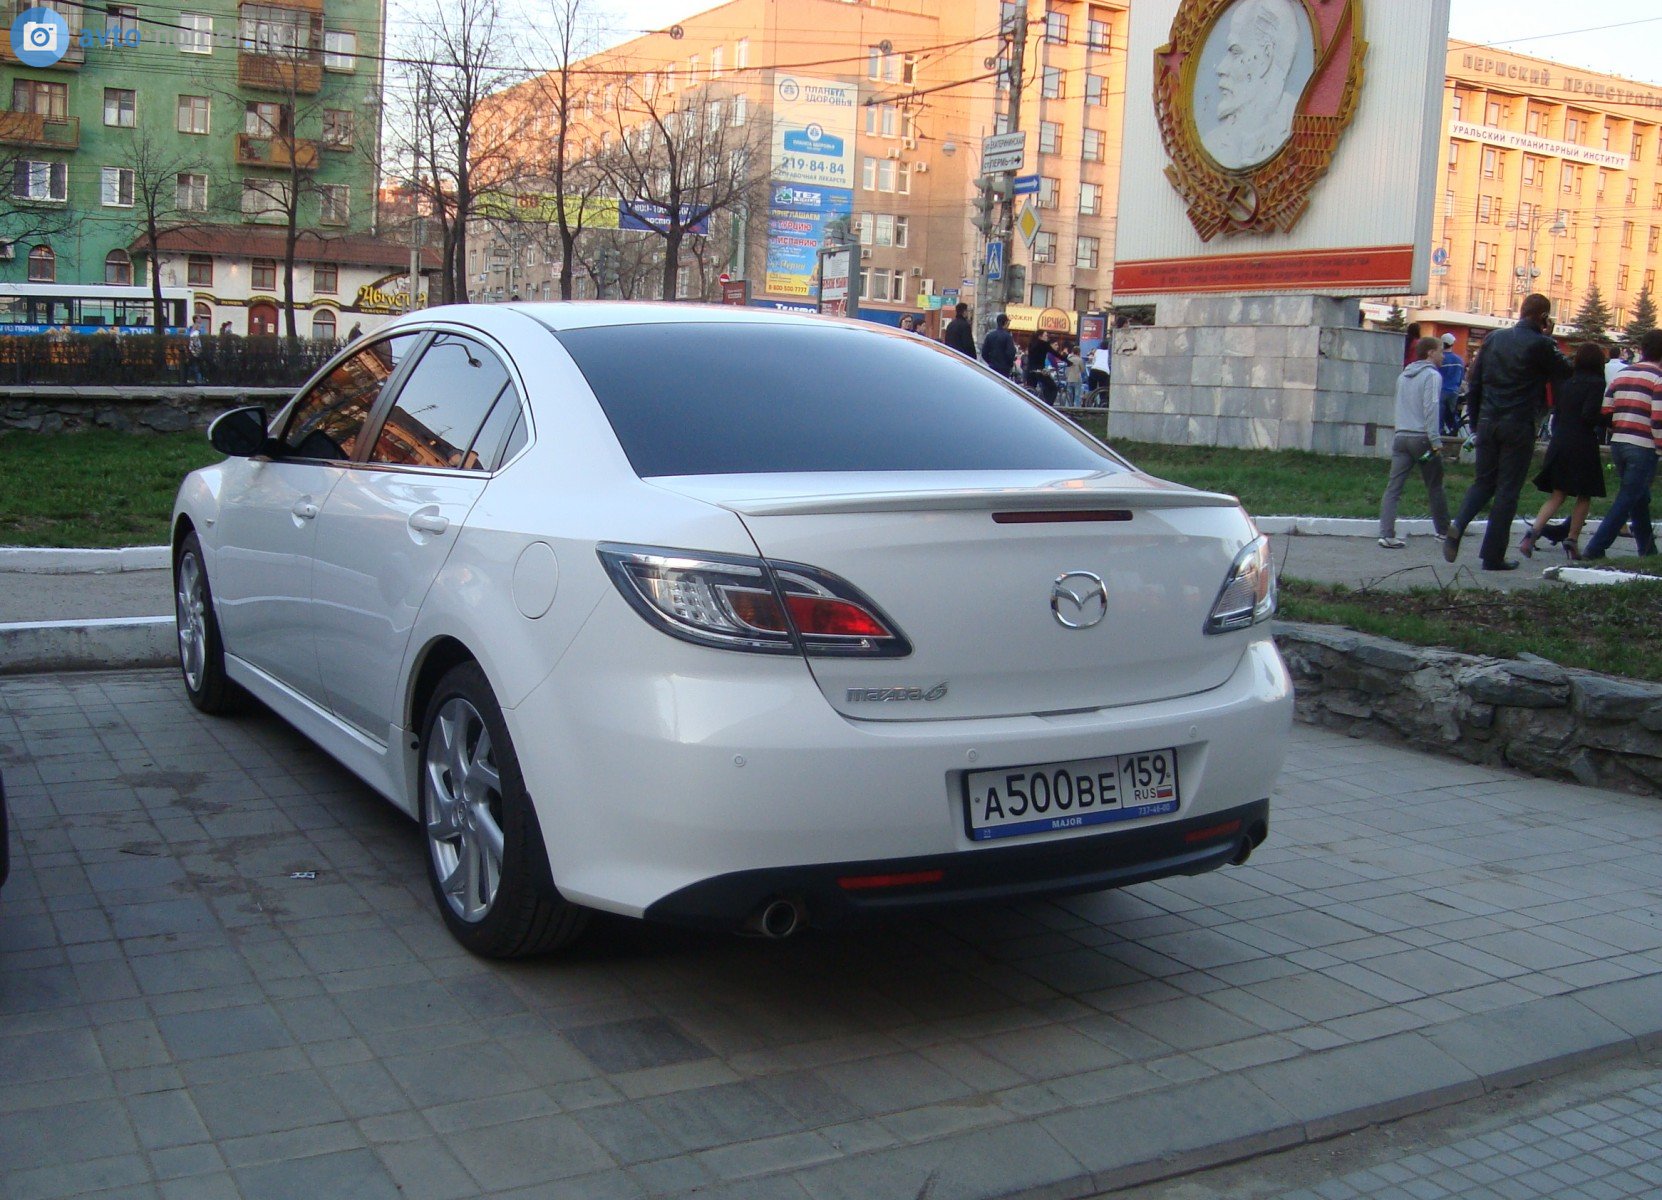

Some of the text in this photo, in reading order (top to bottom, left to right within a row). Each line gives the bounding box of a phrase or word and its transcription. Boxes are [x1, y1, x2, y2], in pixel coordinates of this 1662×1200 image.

[1463, 53, 1551, 86] ПЕРМСКИЙ
[804, 85, 846, 97] ПЛАНЕТА
[806, 93, 852, 107] ЗДОРОВЬЯ
[1453, 123, 1625, 166] УРАЛЬСКИЙ ГУМАНИТАРНЫЙ ИНСТИТУТ
[1123, 754, 1167, 789] 159
[1134, 787, 1157, 801] RUS
[1052, 817, 1082, 829] MAJOR
